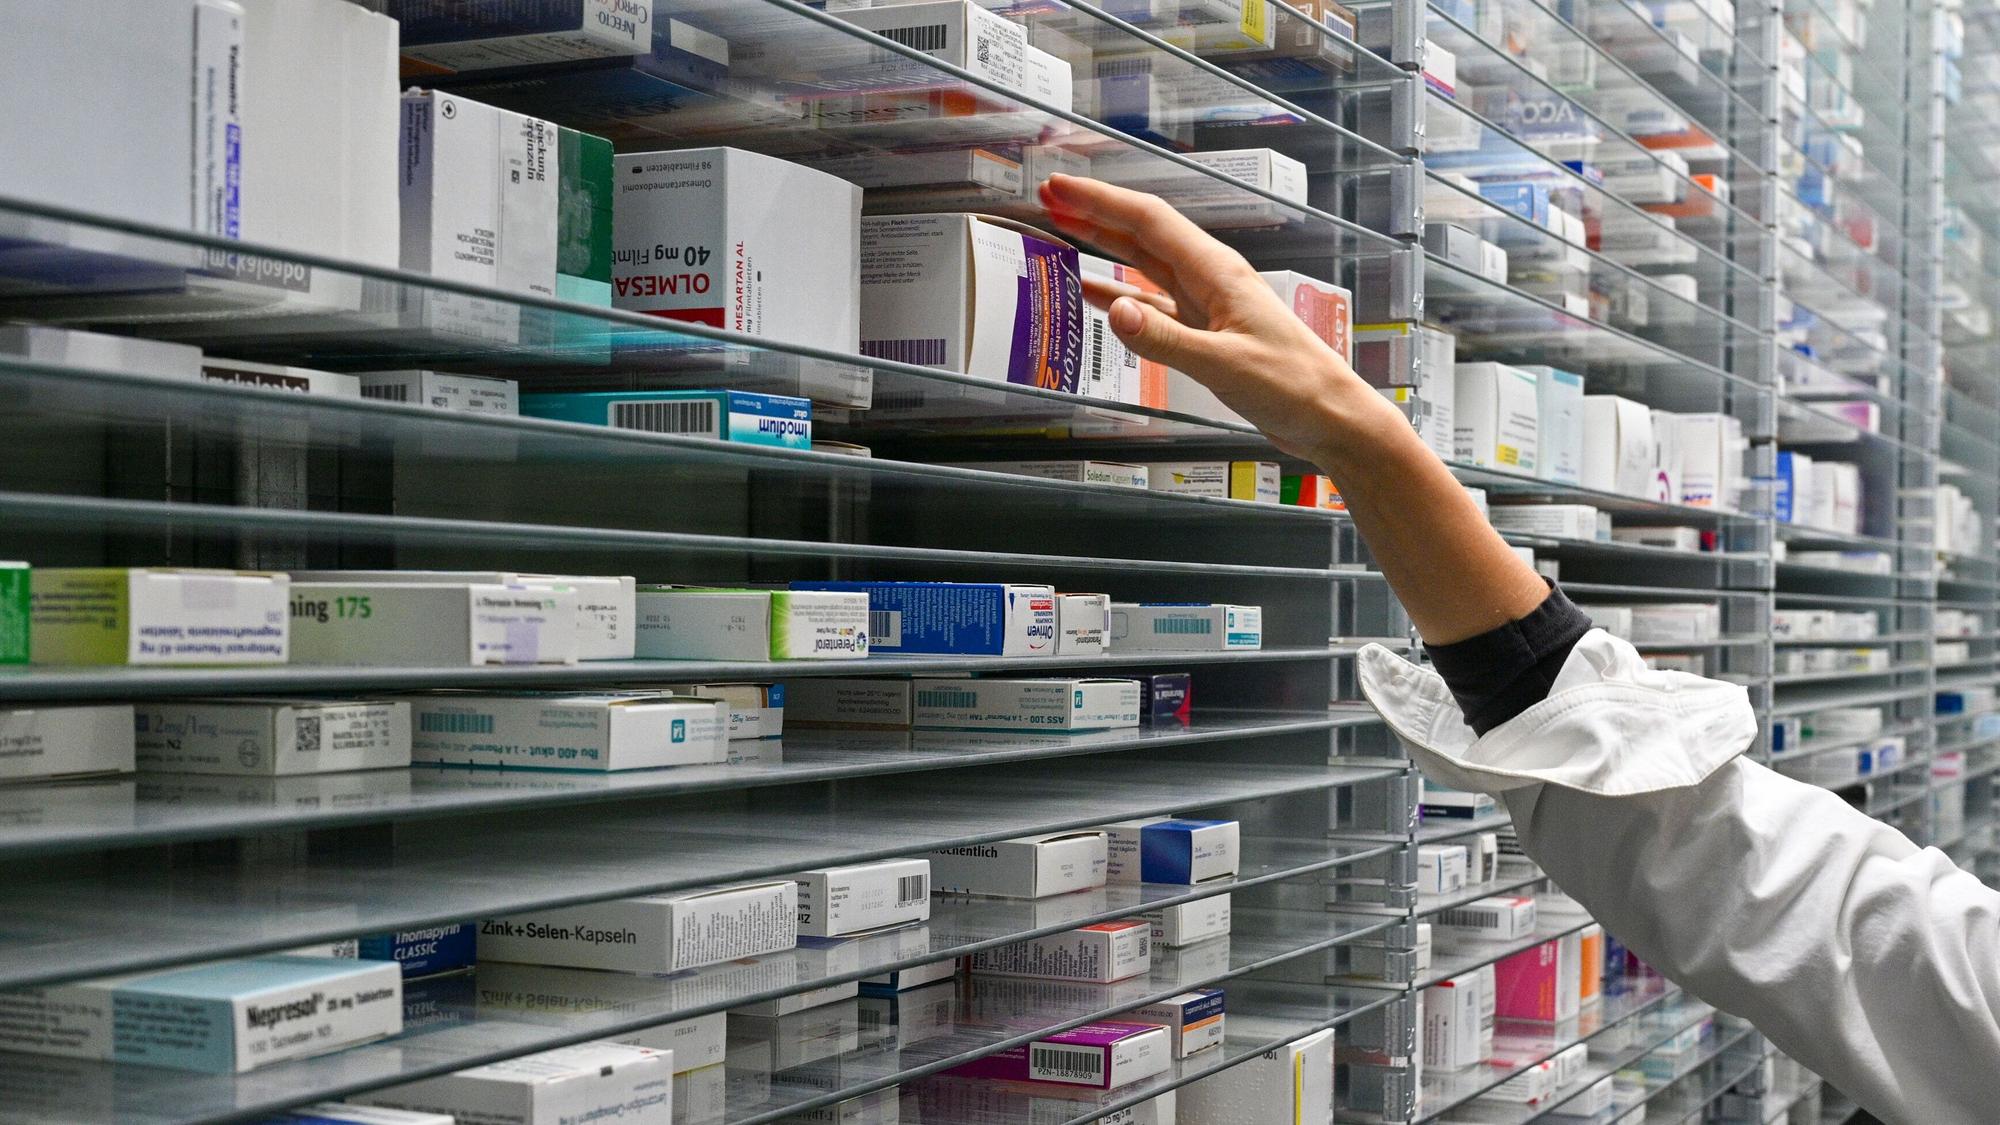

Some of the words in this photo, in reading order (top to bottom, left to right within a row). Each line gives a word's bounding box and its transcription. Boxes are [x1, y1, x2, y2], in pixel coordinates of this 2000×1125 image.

[654, 244, 679, 262] mg
[683, 245, 711, 268] 40
[735, 240, 744, 257] AL
[614, 273, 711, 299] OLMESA
[1049, 254, 1062, 362] Schwangerschaft
[1044, 366, 1061, 390] 2
[758, 419, 808, 440] Imodium
[335, 596, 373, 619] 175
[1027, 625, 1054, 640] Otriven
[1029, 714, 1046, 724] 100
[1046, 715, 1065, 724] ASS
[481, 920, 637, 945] Zink+Selen-Kapseln
[393, 940, 438, 961] CLASSIC
[1037, 1067, 1093, 1080] PZN-18878909
